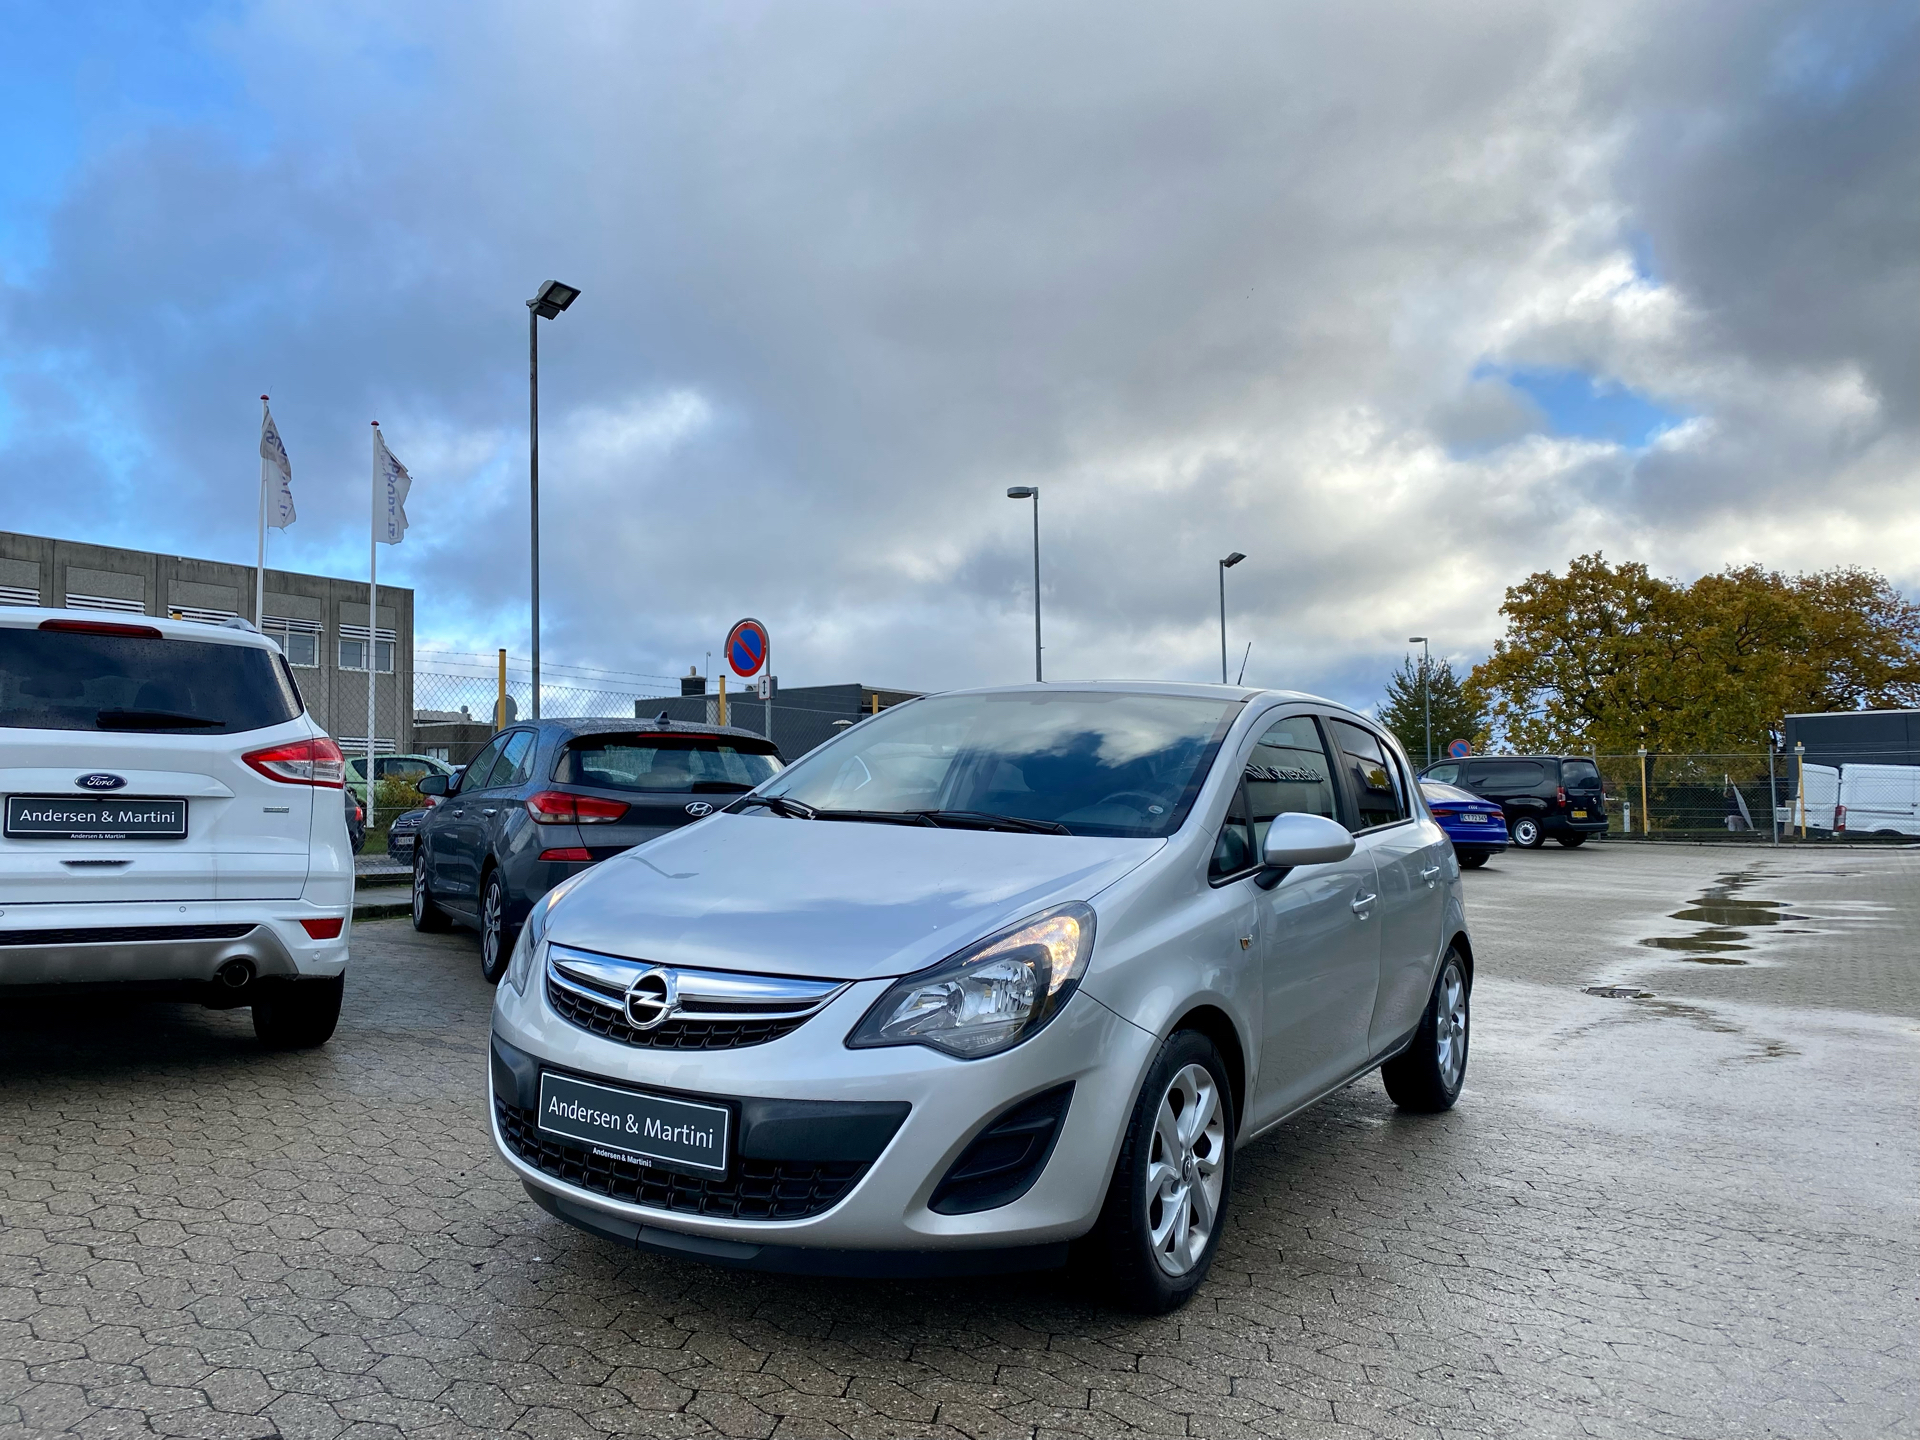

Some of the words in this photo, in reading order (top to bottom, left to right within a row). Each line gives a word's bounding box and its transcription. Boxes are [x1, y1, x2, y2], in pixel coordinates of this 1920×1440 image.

[87, 775, 116, 786] Ford
[19, 809, 97, 822] Andersen
[101, 810, 114, 823] &
[117, 810, 175, 823] Martini
[548, 1095, 621, 1131] Andersen
[625, 1113, 639, 1135] &
[643, 1117, 714, 1149] Martini
[592, 1146, 621, 1161] Andersen
[621, 1154, 627, 1162] &
